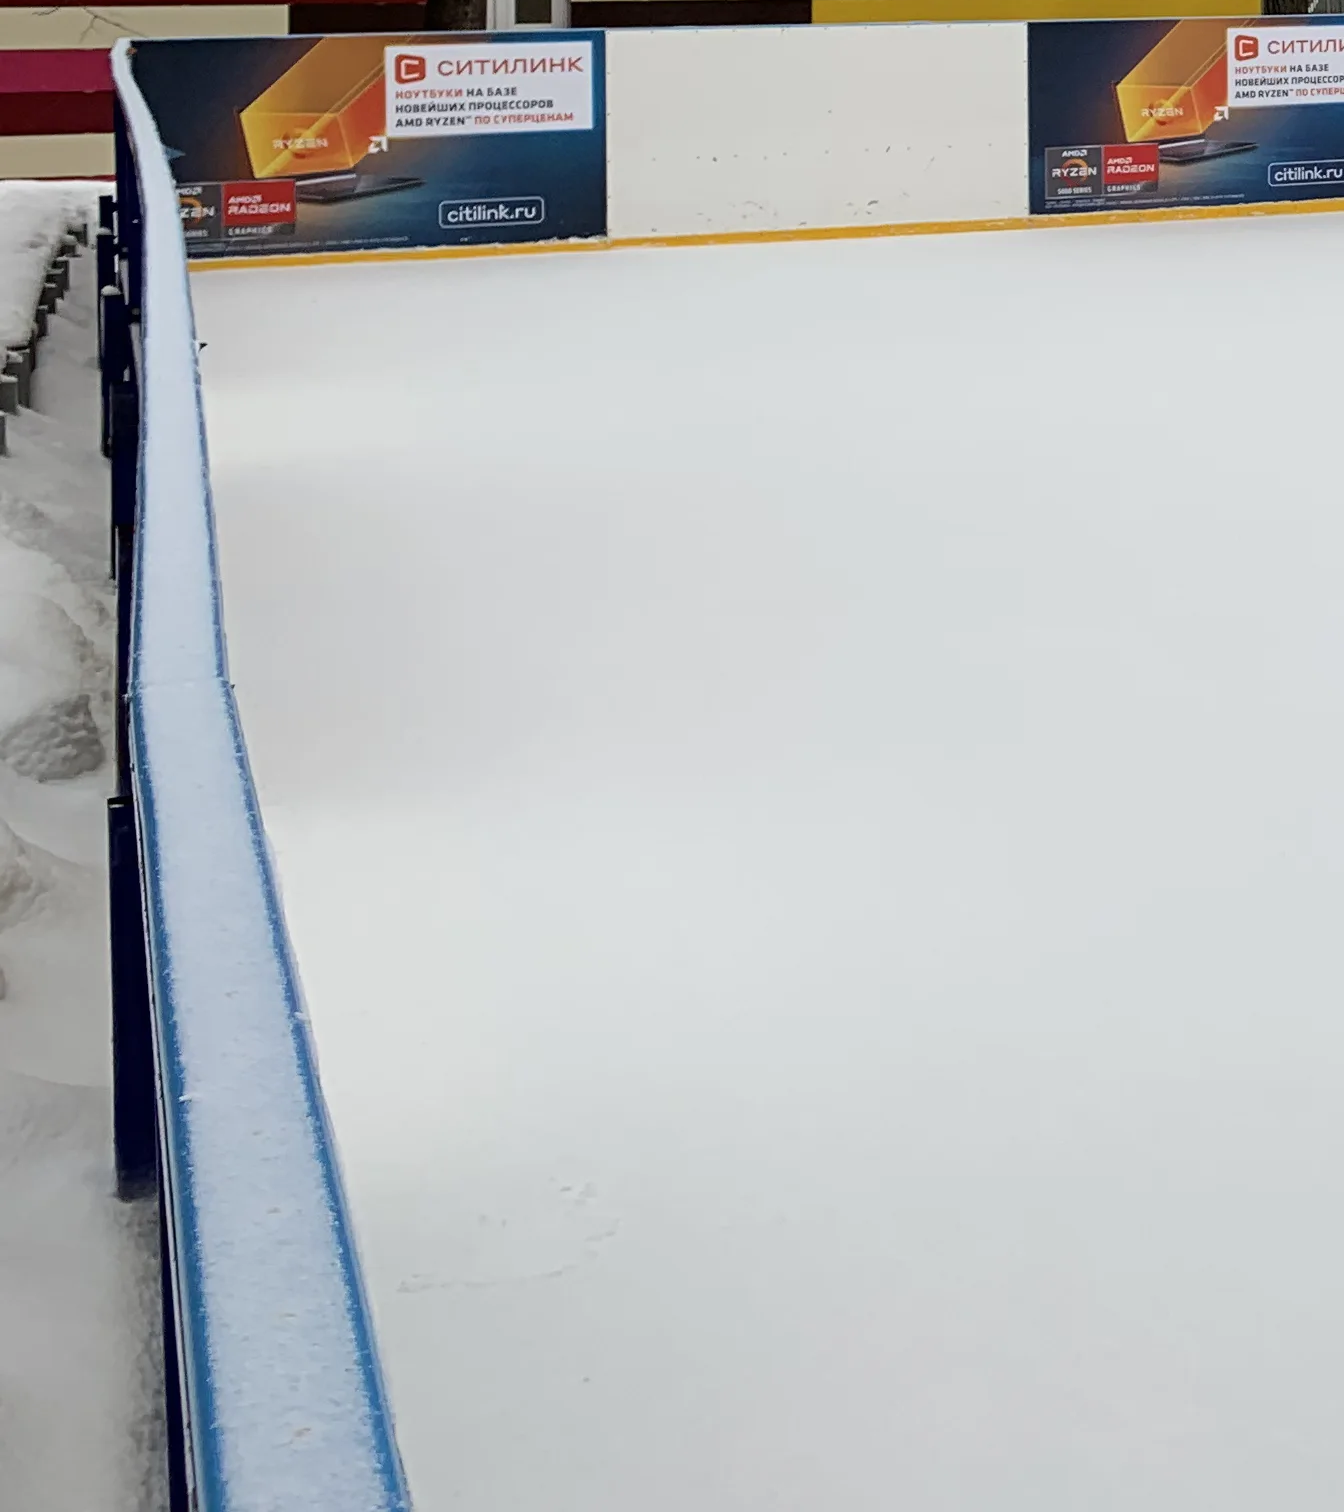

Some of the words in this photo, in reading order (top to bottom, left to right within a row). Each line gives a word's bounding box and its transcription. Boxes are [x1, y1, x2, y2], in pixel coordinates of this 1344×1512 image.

[437, 56, 583, 76] СИТИЛИНК
[1235, 65, 1286, 74] НОУТБУКИ
[1289, 64, 1302, 72] НА
[1305, 63, 1328, 72] БАЗЕ
[1235, 76, 1288, 86] НОВЕЙШИХ
[395, 88, 462, 99] НОУТБУКИ
[466, 88, 483, 97] НА
[487, 86, 517, 96] БАЗЕ
[1235, 90, 1255, 98] AMD
[395, 101, 465, 113] НОВЕЙШИХ
[468, 99, 553, 111] ПРОЦЕССОРОВ
[1141, 107, 1183, 117] RYZEN
[395, 117, 422, 127] AMD
[474, 116, 490, 124] ПО
[493, 112, 573, 124] СУПЕРЦЕНАМ
[272, 137, 328, 149] RYZEN
[1061, 149, 1082, 157] AMD
[1052, 167, 1096, 177] RYZEN
[1106, 164, 1154, 173] RADEON
[1274, 165, 1342, 181] citilink.ru
[228, 195, 256, 204] AMD
[228, 203, 290, 214] RADEON
[447, 203, 535, 222] citilink.ru
